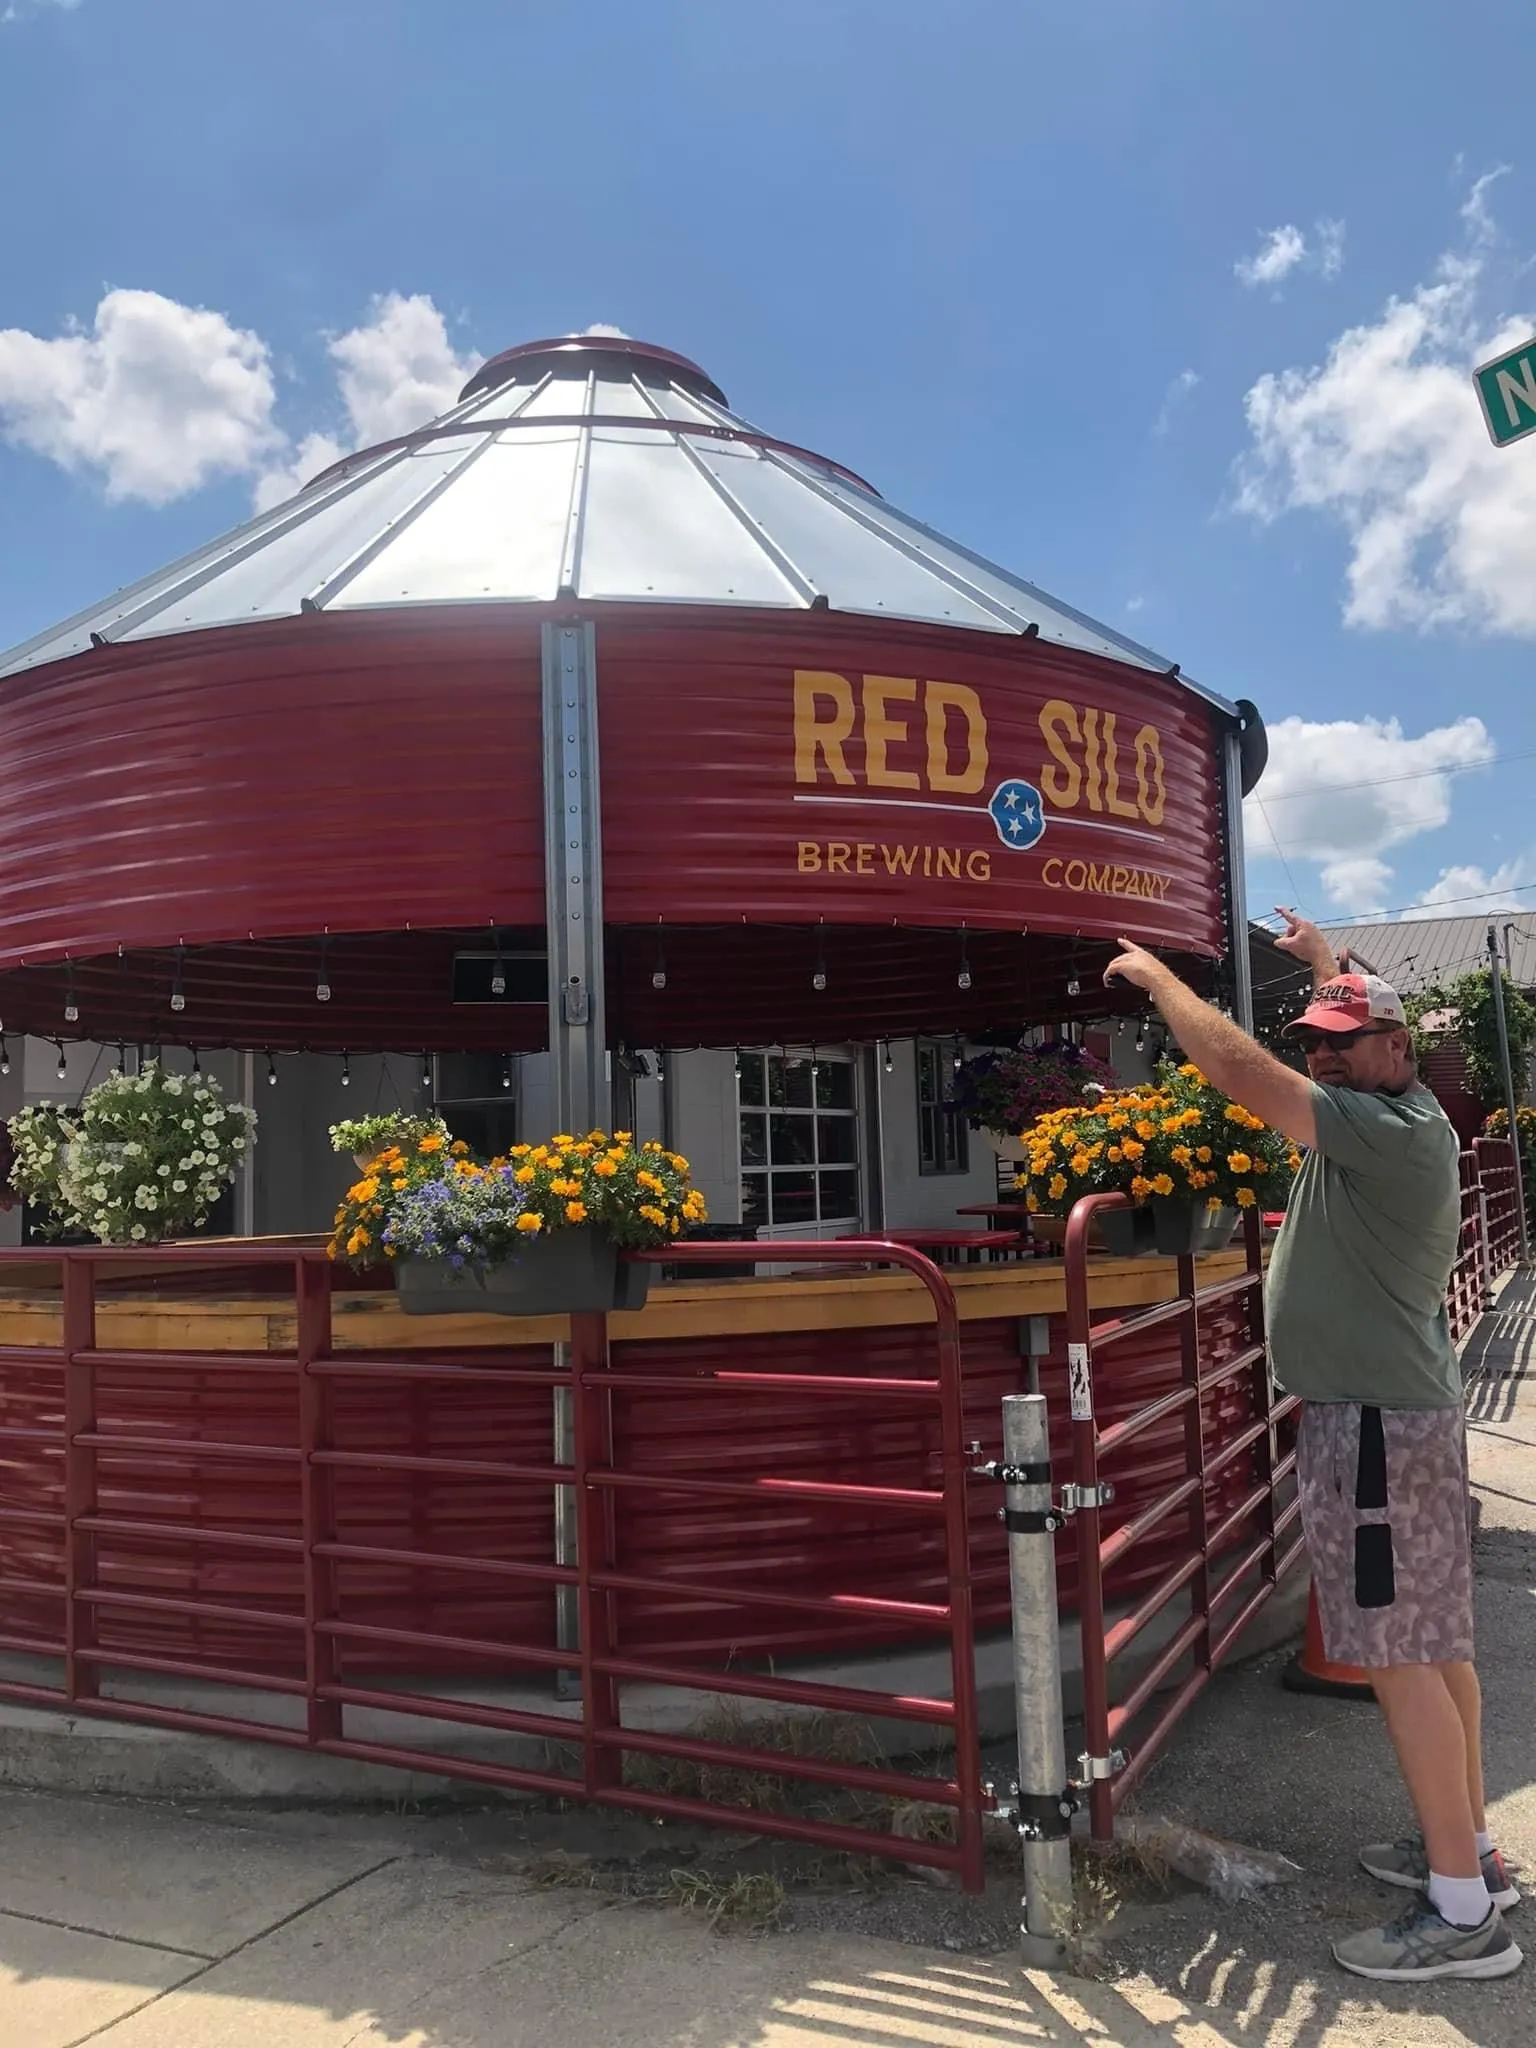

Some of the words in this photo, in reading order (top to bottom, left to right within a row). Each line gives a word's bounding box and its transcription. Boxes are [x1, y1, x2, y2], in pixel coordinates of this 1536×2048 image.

[1496, 358, 1536, 427] N
[793, 669, 989, 795] RED
[1039, 699, 1166, 826] SILO
[797, 841, 991, 882] BREWING
[1041, 857, 1171, 901] COMPANY
